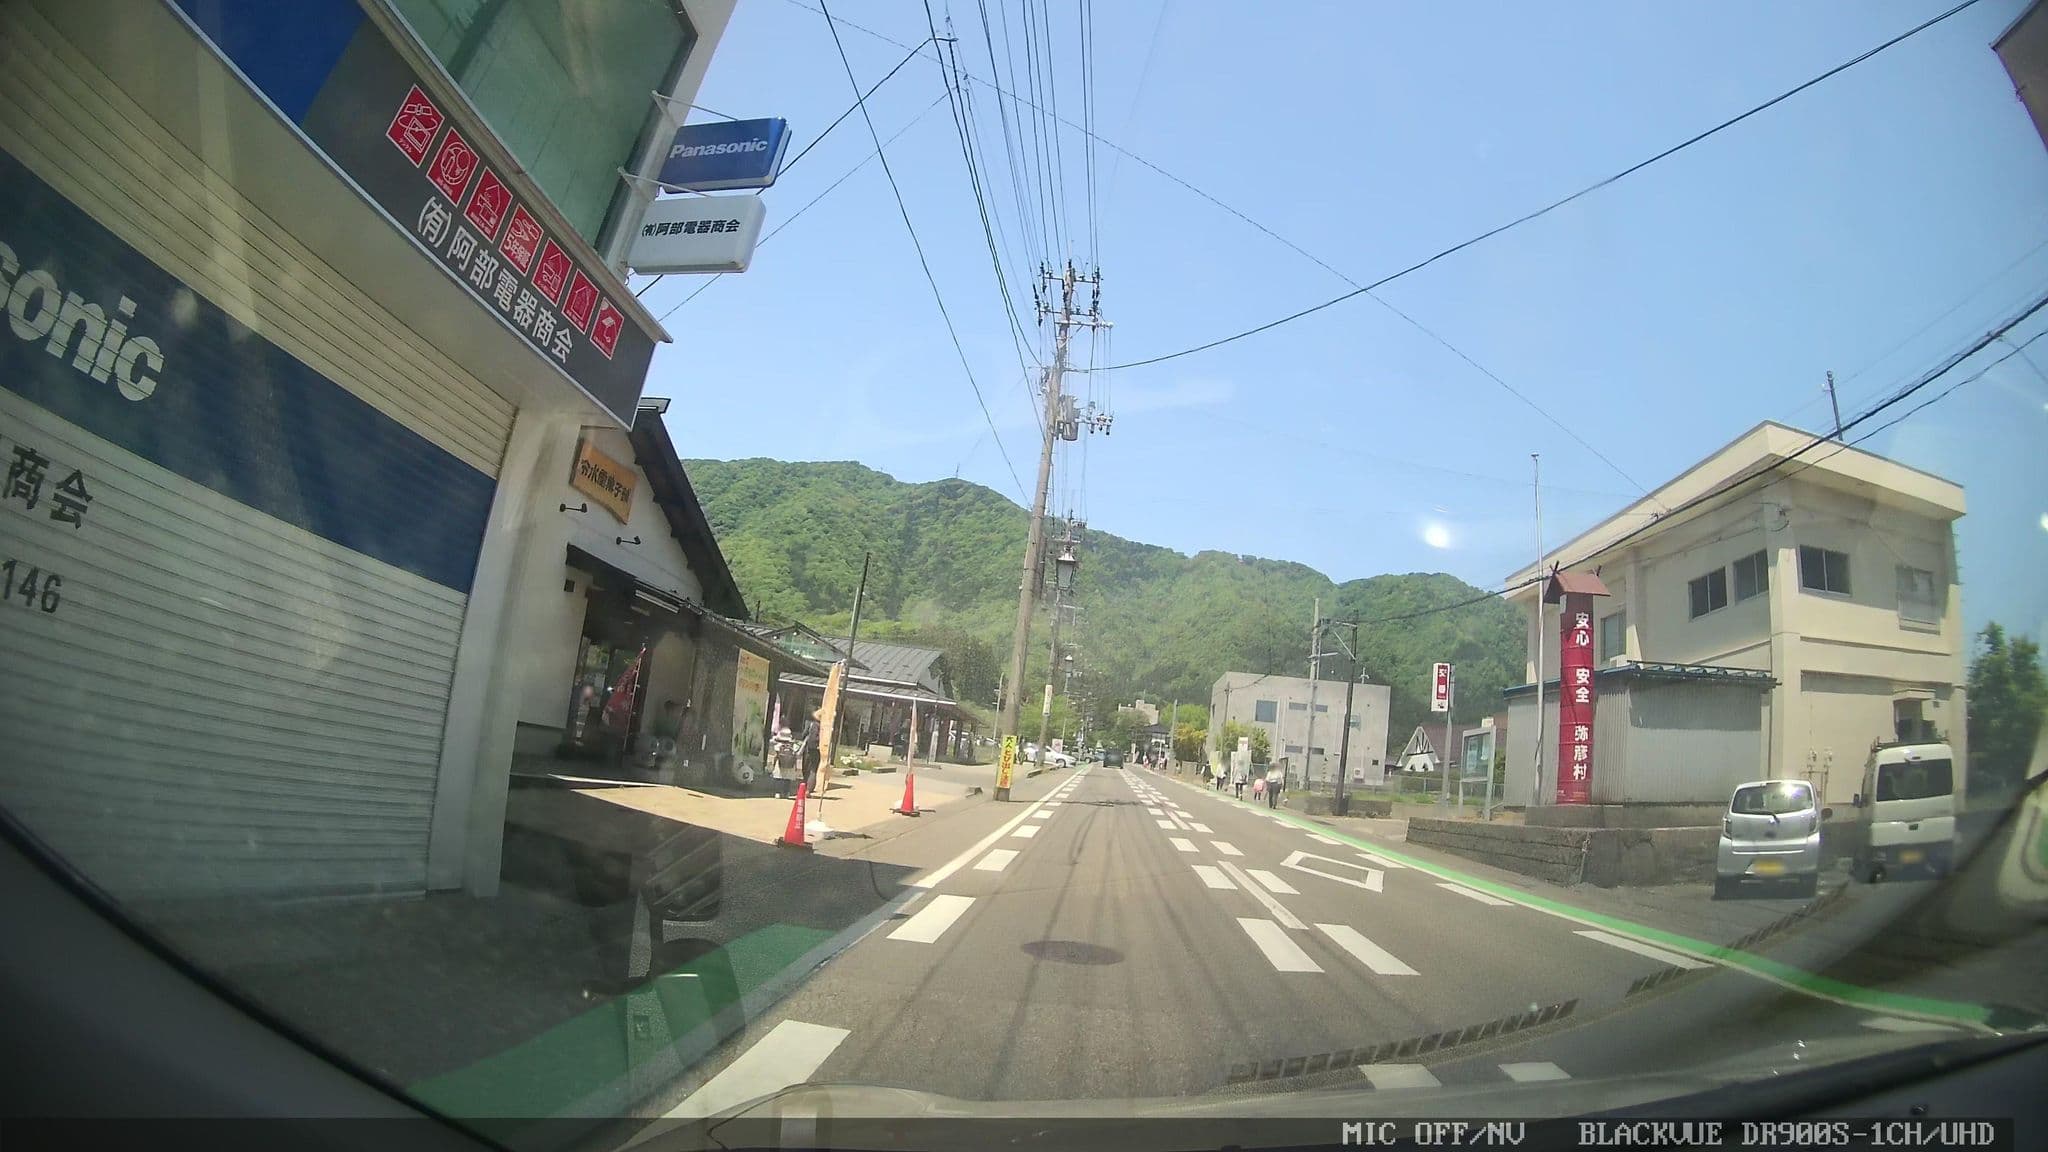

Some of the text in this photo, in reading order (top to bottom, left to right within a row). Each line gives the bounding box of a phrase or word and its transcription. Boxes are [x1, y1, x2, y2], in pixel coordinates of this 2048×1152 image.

[669, 138, 768, 159] Panasonic
[641, 219, 740, 238] (有)阿部電器商会
[417, 196, 573, 364] (有)阿部電器商会
[2, 445, 93, 529] 商会
[1573, 612, 1590, 781] 安心 安全 弥彦村
